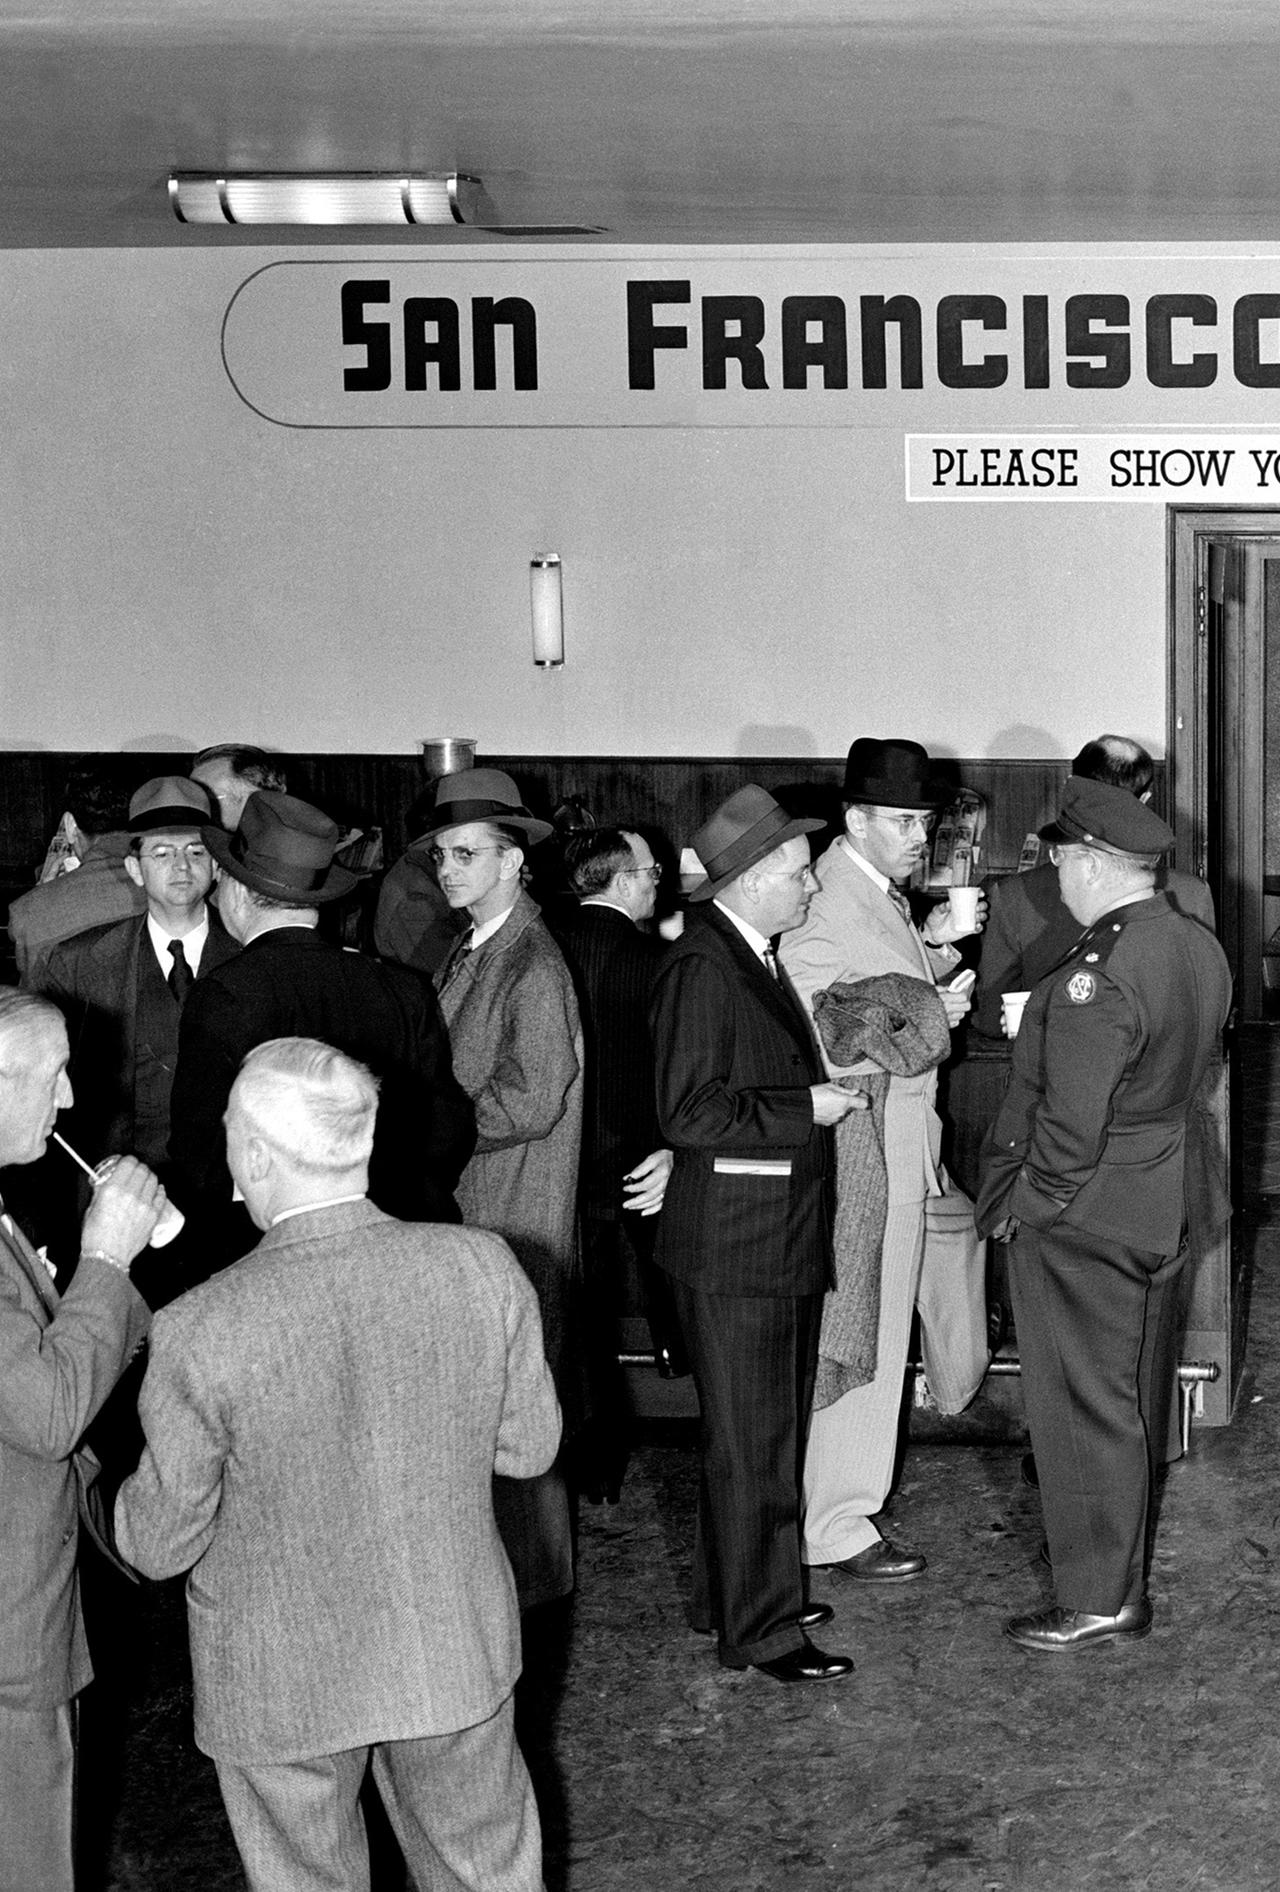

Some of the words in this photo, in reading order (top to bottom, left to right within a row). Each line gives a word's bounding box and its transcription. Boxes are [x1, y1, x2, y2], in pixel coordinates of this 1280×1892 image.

[340, 279, 539, 393] SAN
[931, 448, 1079, 487] PLEASE
[1109, 448, 1236, 488] SHOW
